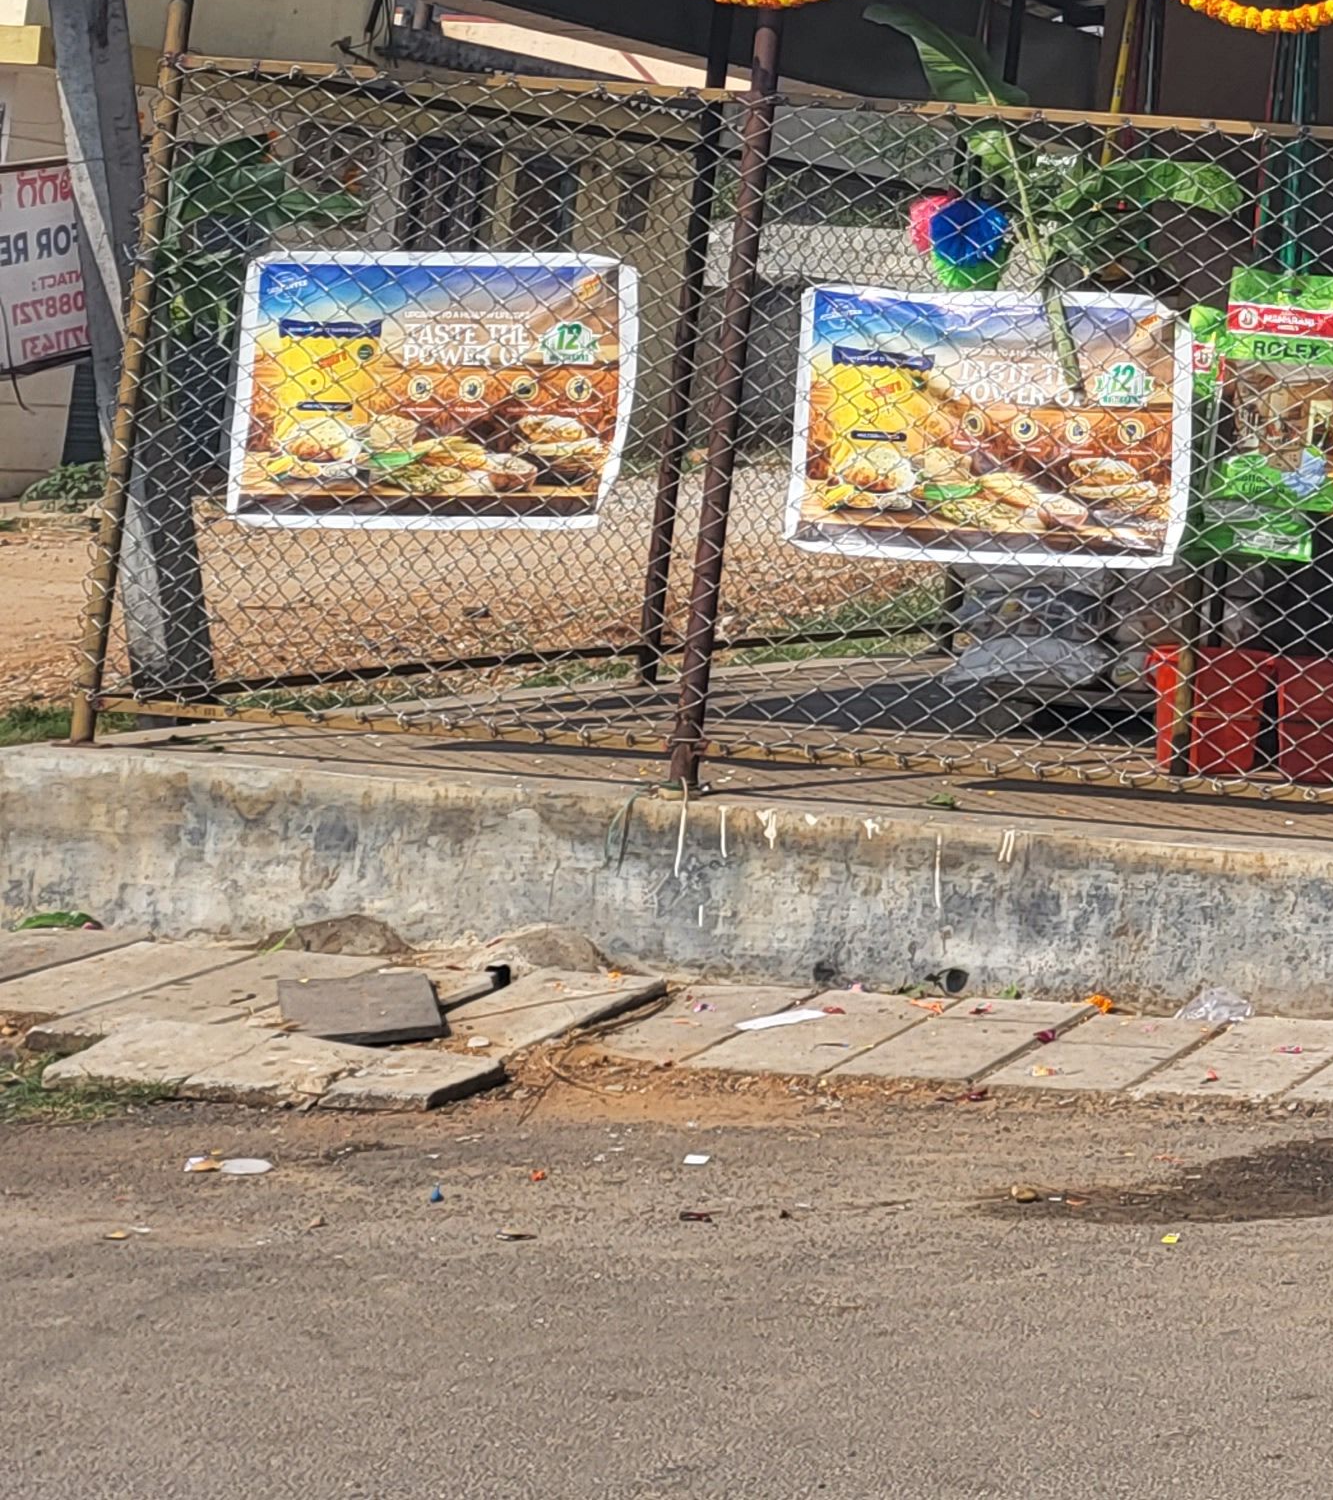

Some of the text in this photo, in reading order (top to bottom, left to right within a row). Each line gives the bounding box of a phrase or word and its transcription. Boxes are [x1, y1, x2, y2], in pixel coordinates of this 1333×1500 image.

[404, 323, 531, 345] TASTE THE
[556, 323, 582, 350] 12
[1253, 340, 1321, 358] ROLEX
[1111, 364, 1136, 391] 12
